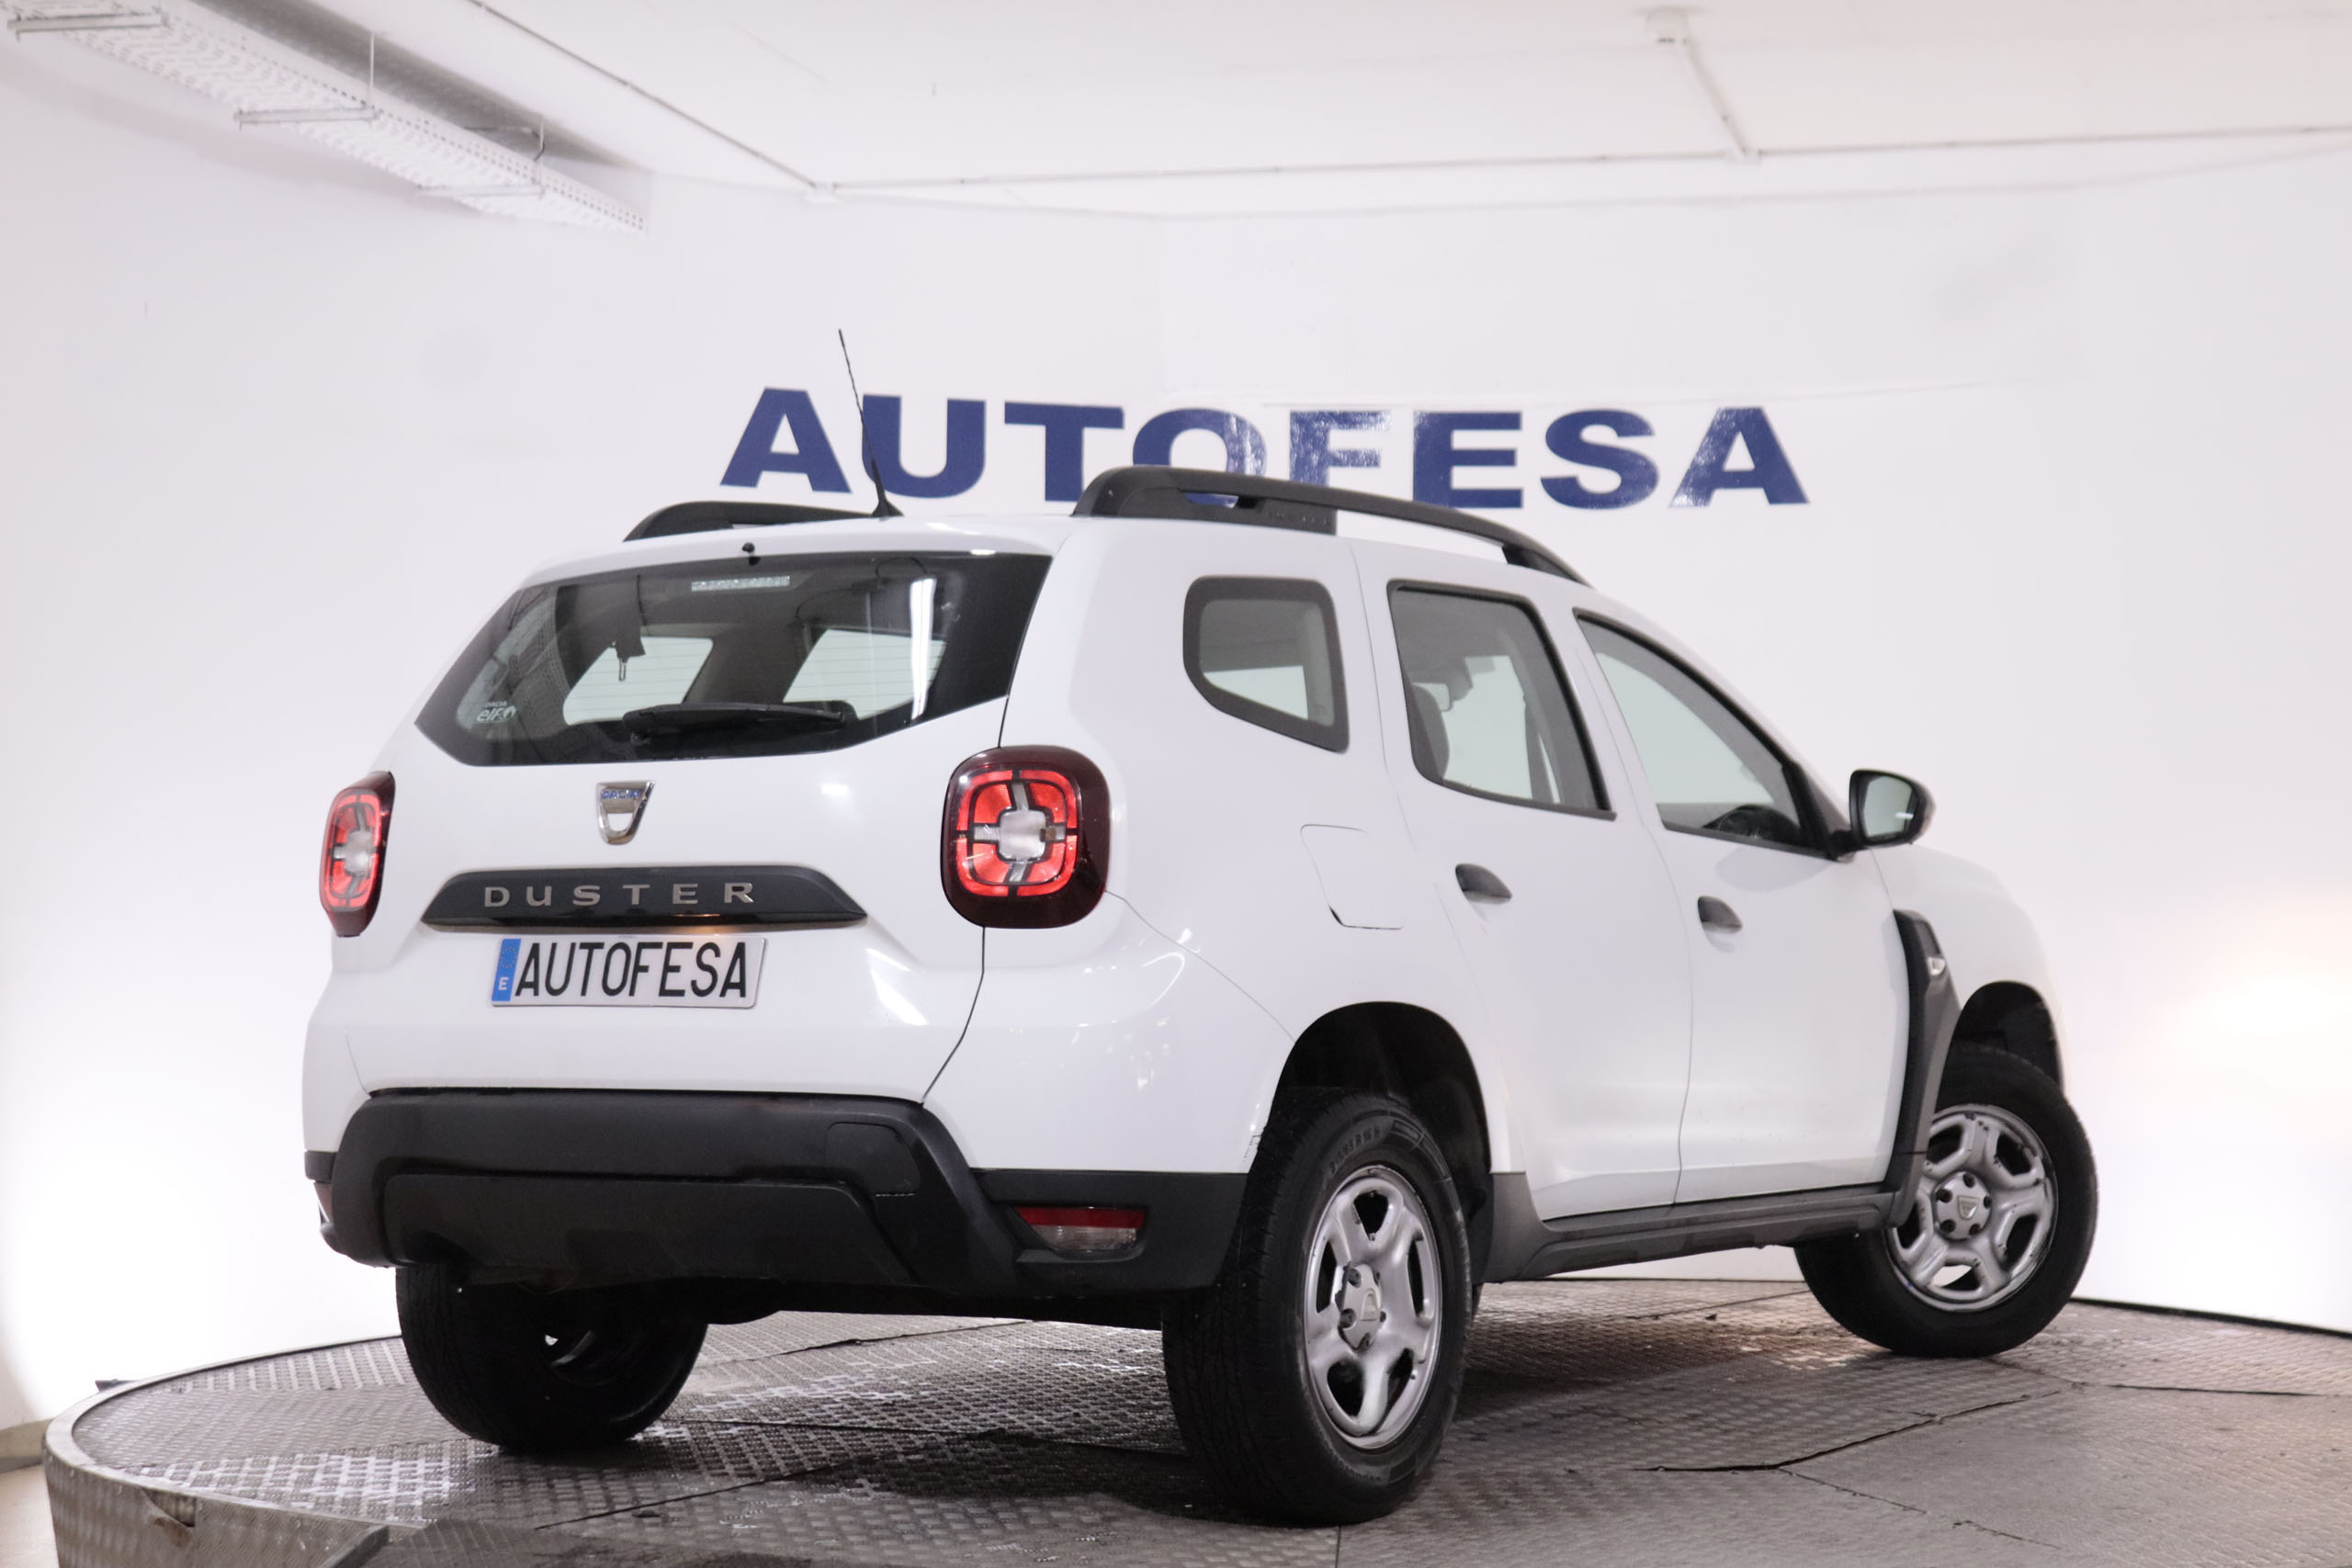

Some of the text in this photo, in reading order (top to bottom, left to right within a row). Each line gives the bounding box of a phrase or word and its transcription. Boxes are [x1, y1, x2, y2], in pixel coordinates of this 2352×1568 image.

[720, 387, 1810, 510] AUTOFESA
[484, 882, 755, 908] DUSTER
[497, 976, 509, 991] E
[515, 942, 747, 998] AUTOFESA
